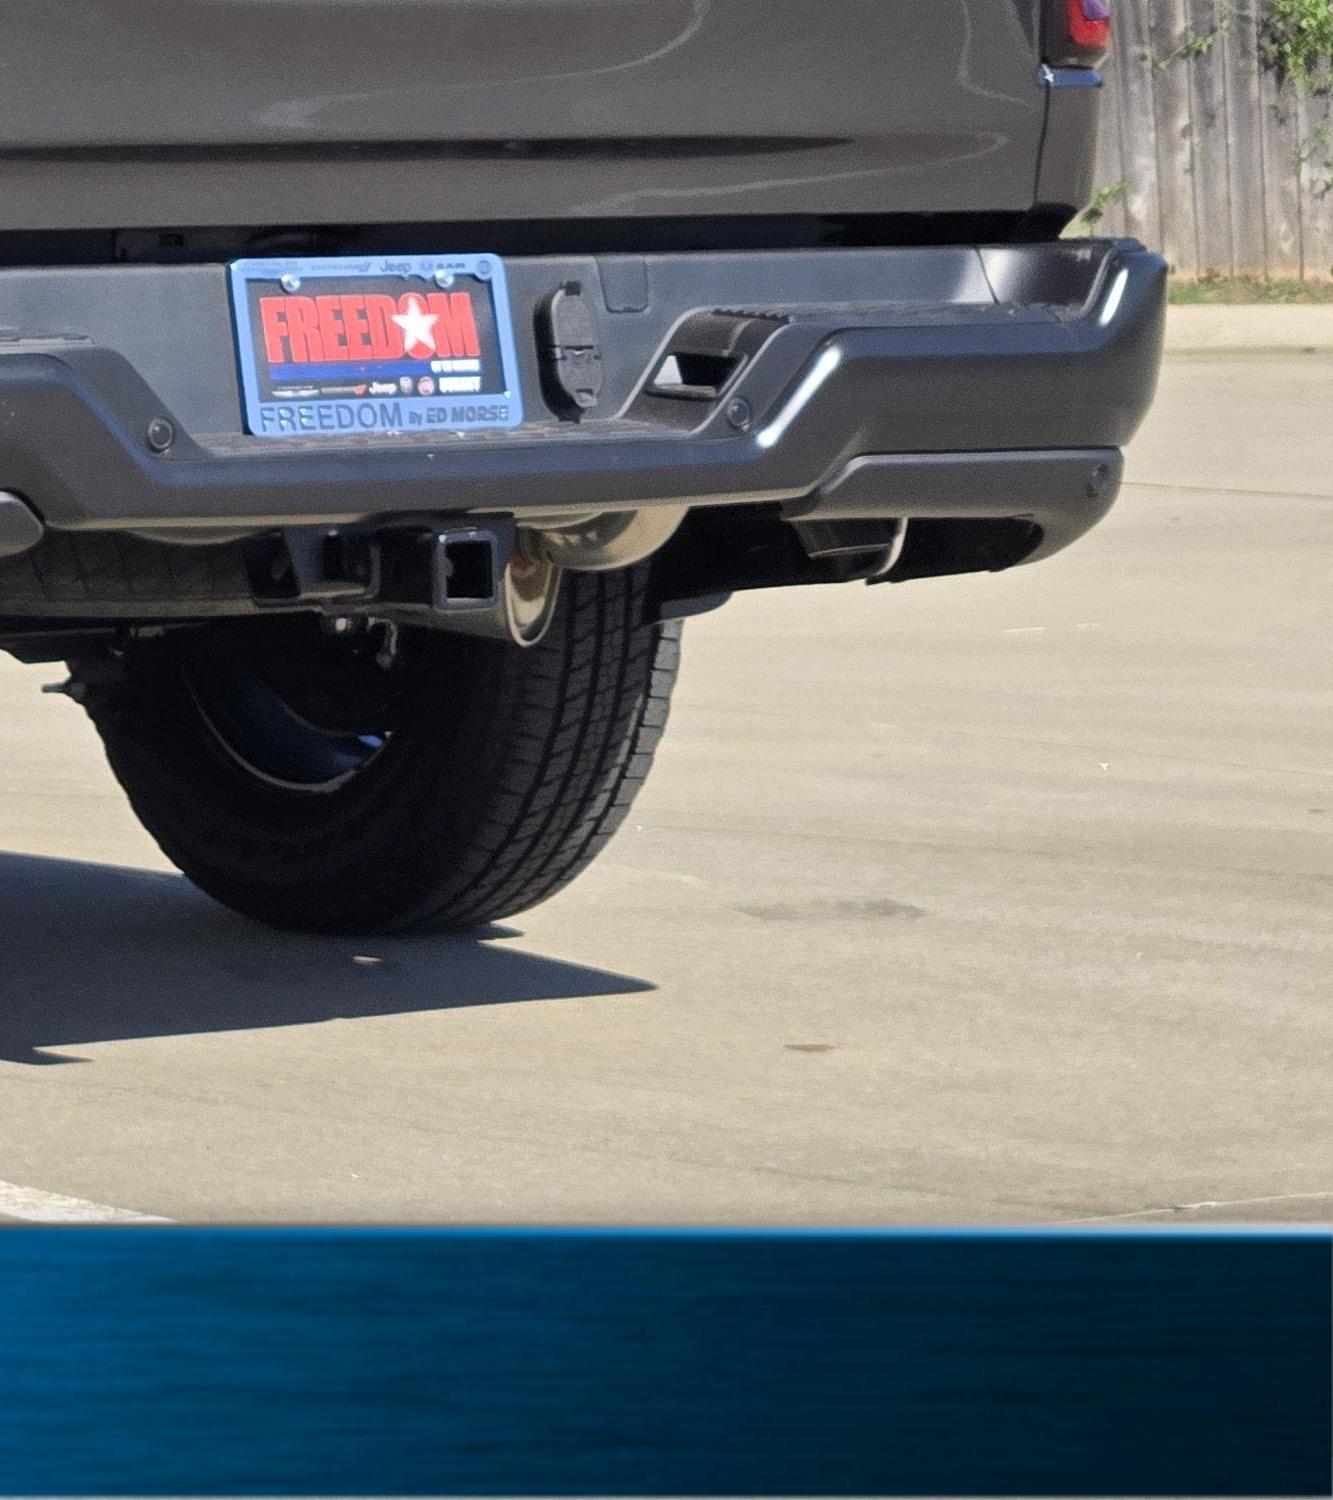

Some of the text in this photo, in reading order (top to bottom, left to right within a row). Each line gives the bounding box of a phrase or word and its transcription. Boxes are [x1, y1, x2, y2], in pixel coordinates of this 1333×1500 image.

[259, 292, 481, 363] FREEDOM
[260, 402, 403, 432] FREEDOM
[426, 407, 448, 423] ED
[451, 405, 509, 423] MORSE
